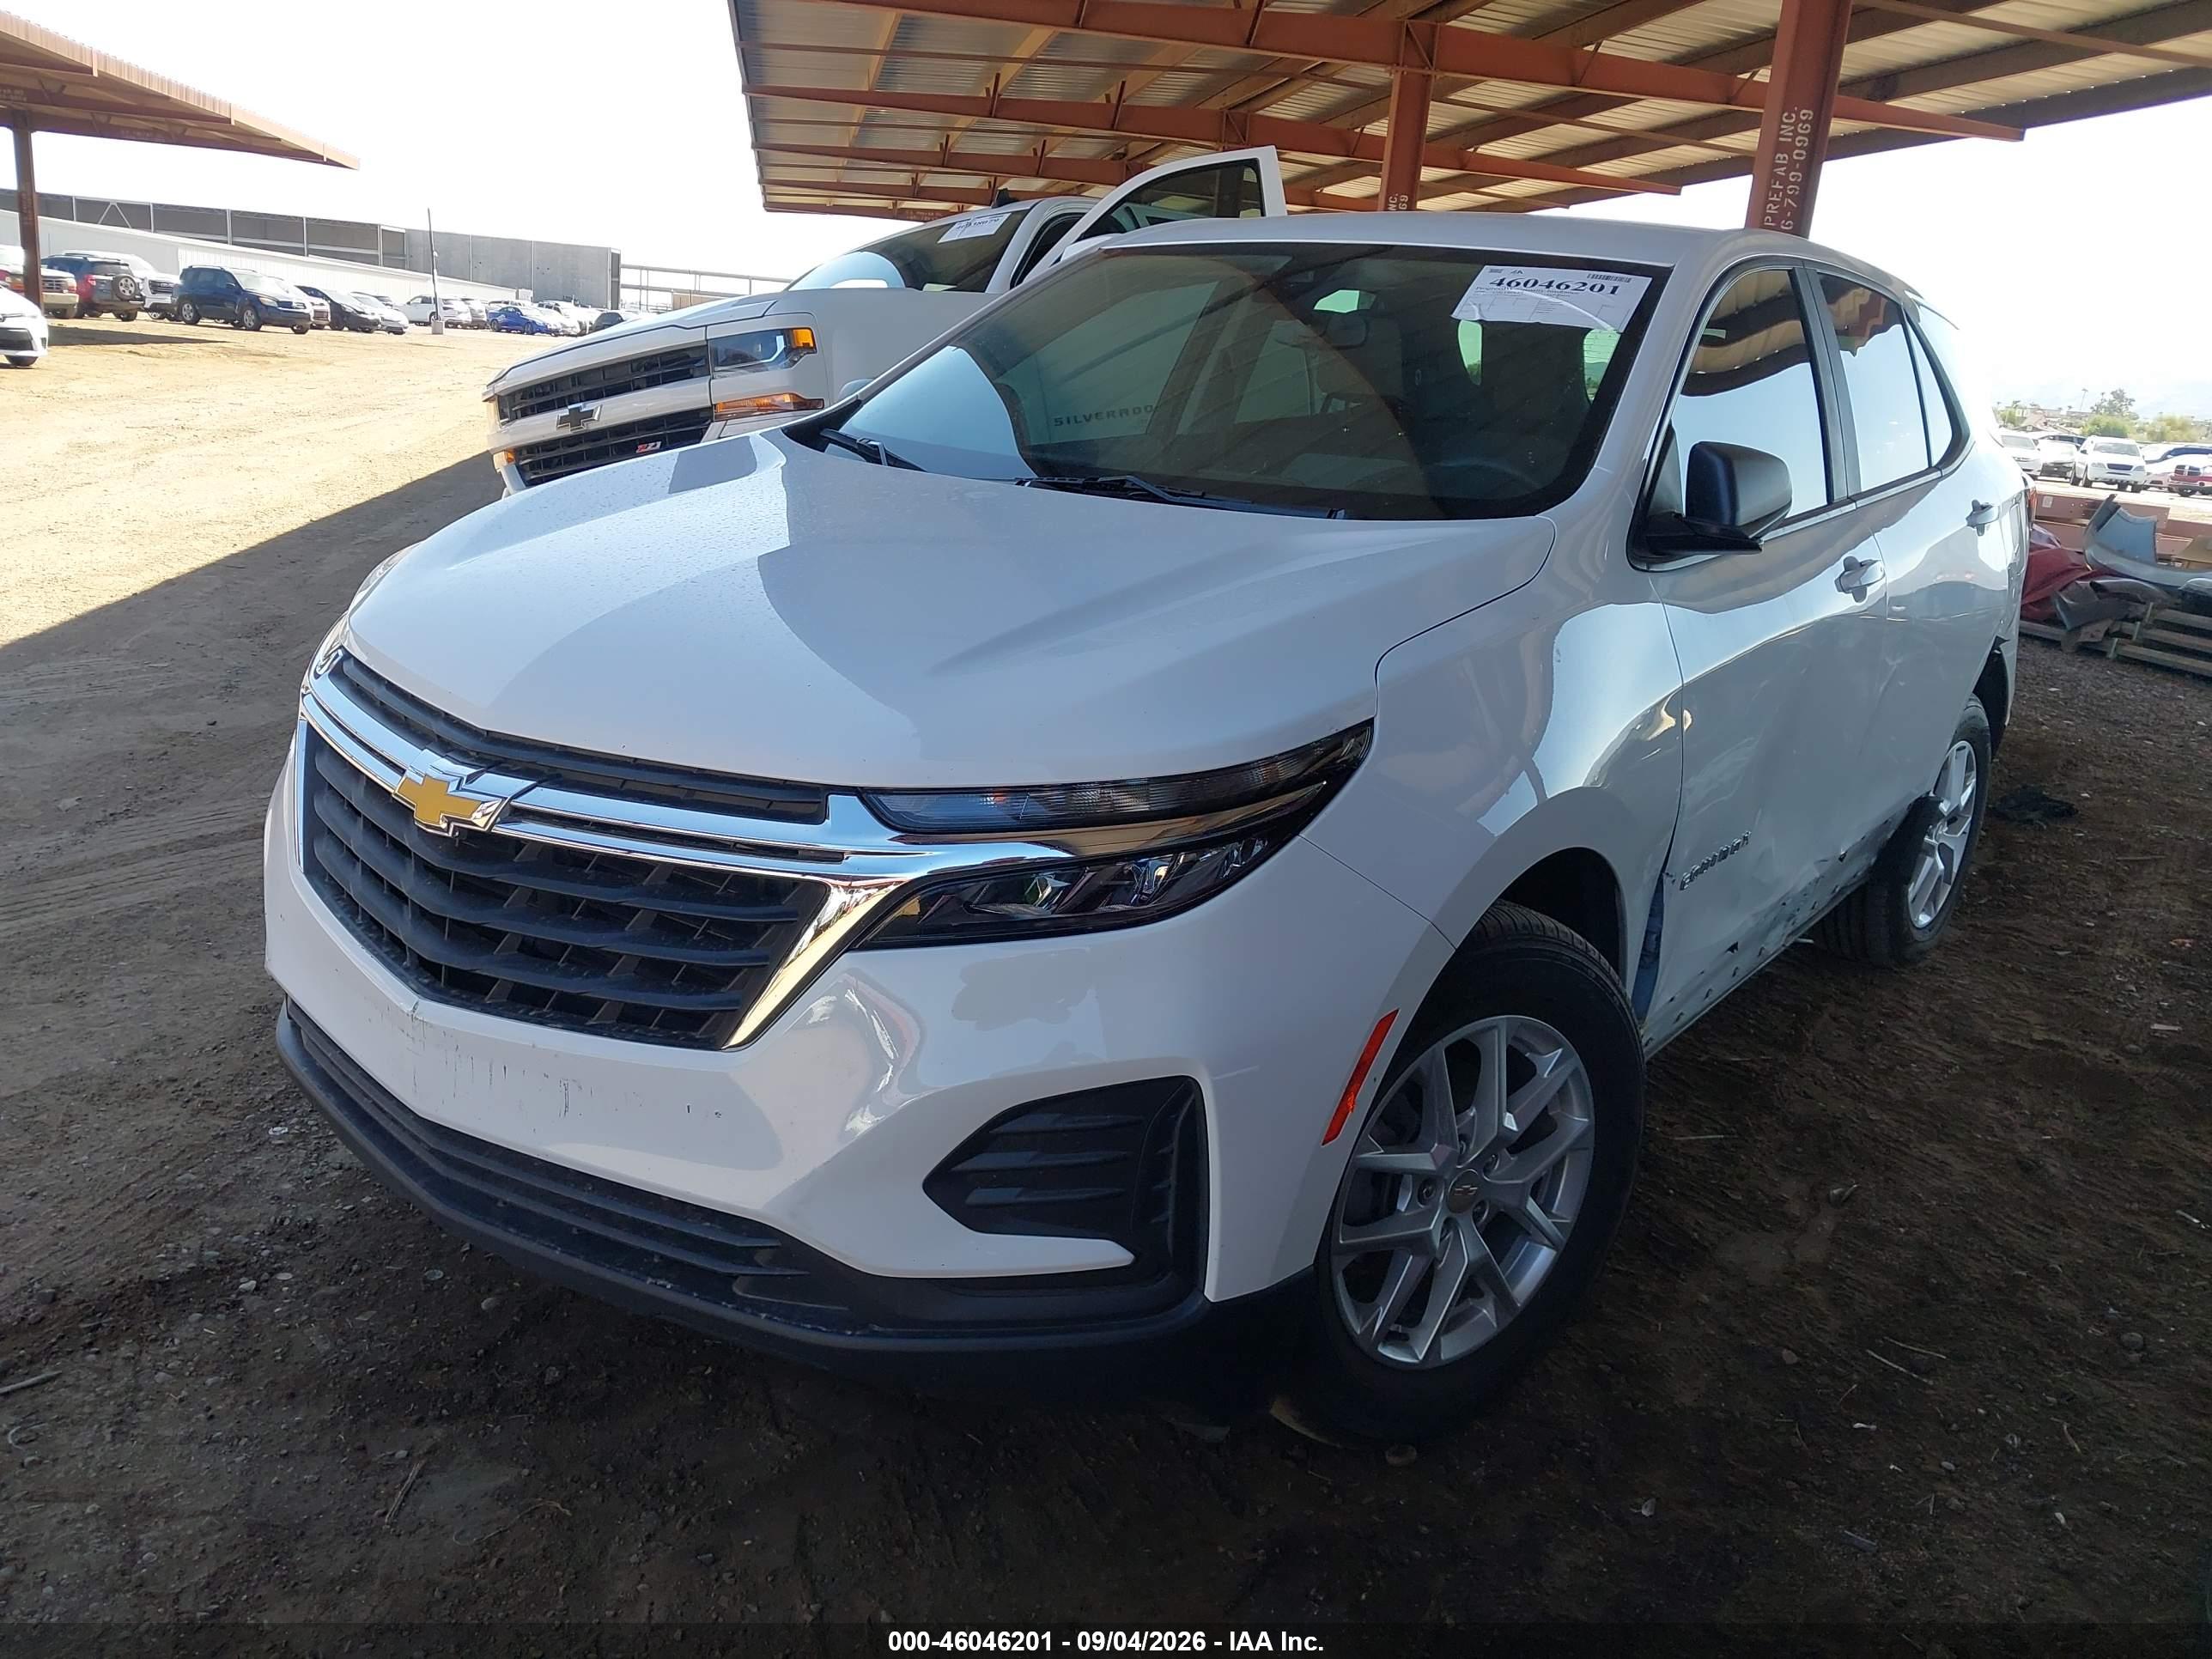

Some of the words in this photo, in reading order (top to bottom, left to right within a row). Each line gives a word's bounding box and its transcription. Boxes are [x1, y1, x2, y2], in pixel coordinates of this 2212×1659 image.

[1763, 153, 1790, 227] PREFAB
[1778, 106, 1798, 143] INC.
[1489, 276, 1621, 296] 46046201
[1054, 404, 1154, 427] SILVERADO
[1680, 830, 1752, 891] EQUINOX
